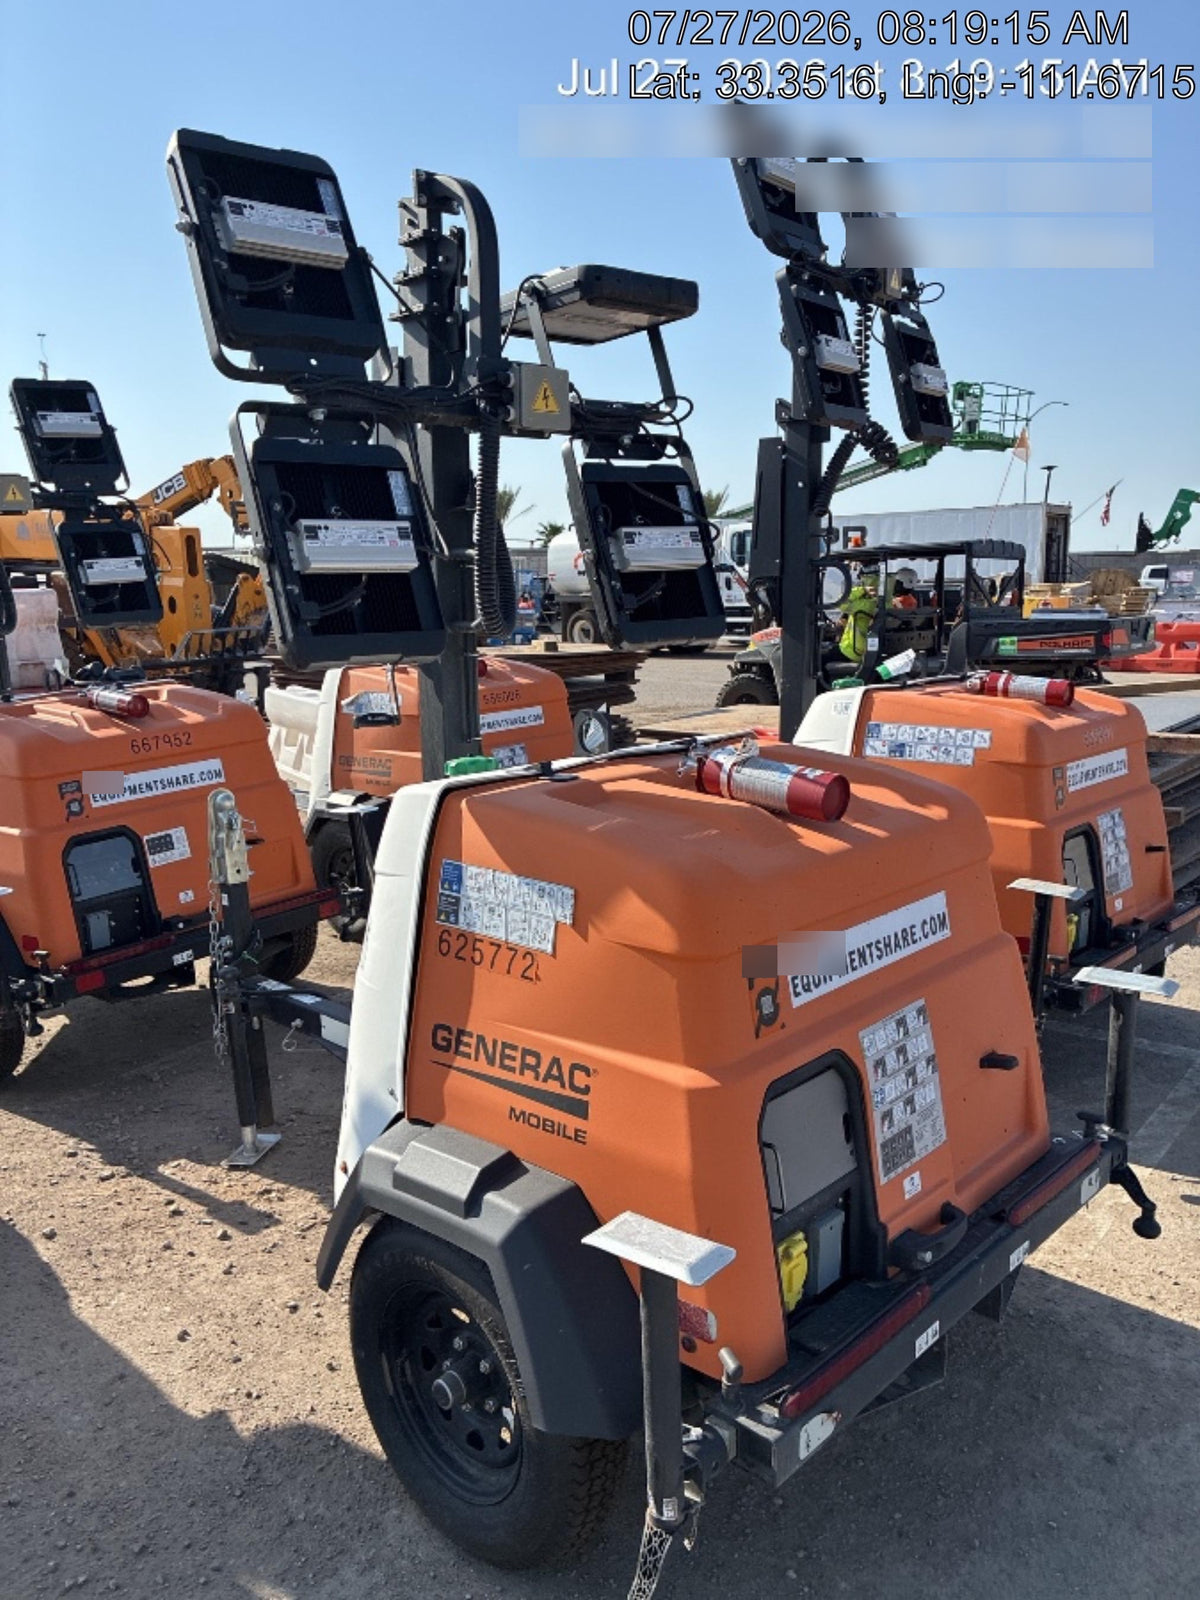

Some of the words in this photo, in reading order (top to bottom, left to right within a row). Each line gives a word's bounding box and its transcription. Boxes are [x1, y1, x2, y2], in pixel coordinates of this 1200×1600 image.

[153, 473, 187, 504] JCB
[130, 731, 193, 754] 667952
[438, 929, 535, 982] 625772
[431, 1023, 591, 1096] GENERAC
[509, 1106, 588, 1146] MOBILE
